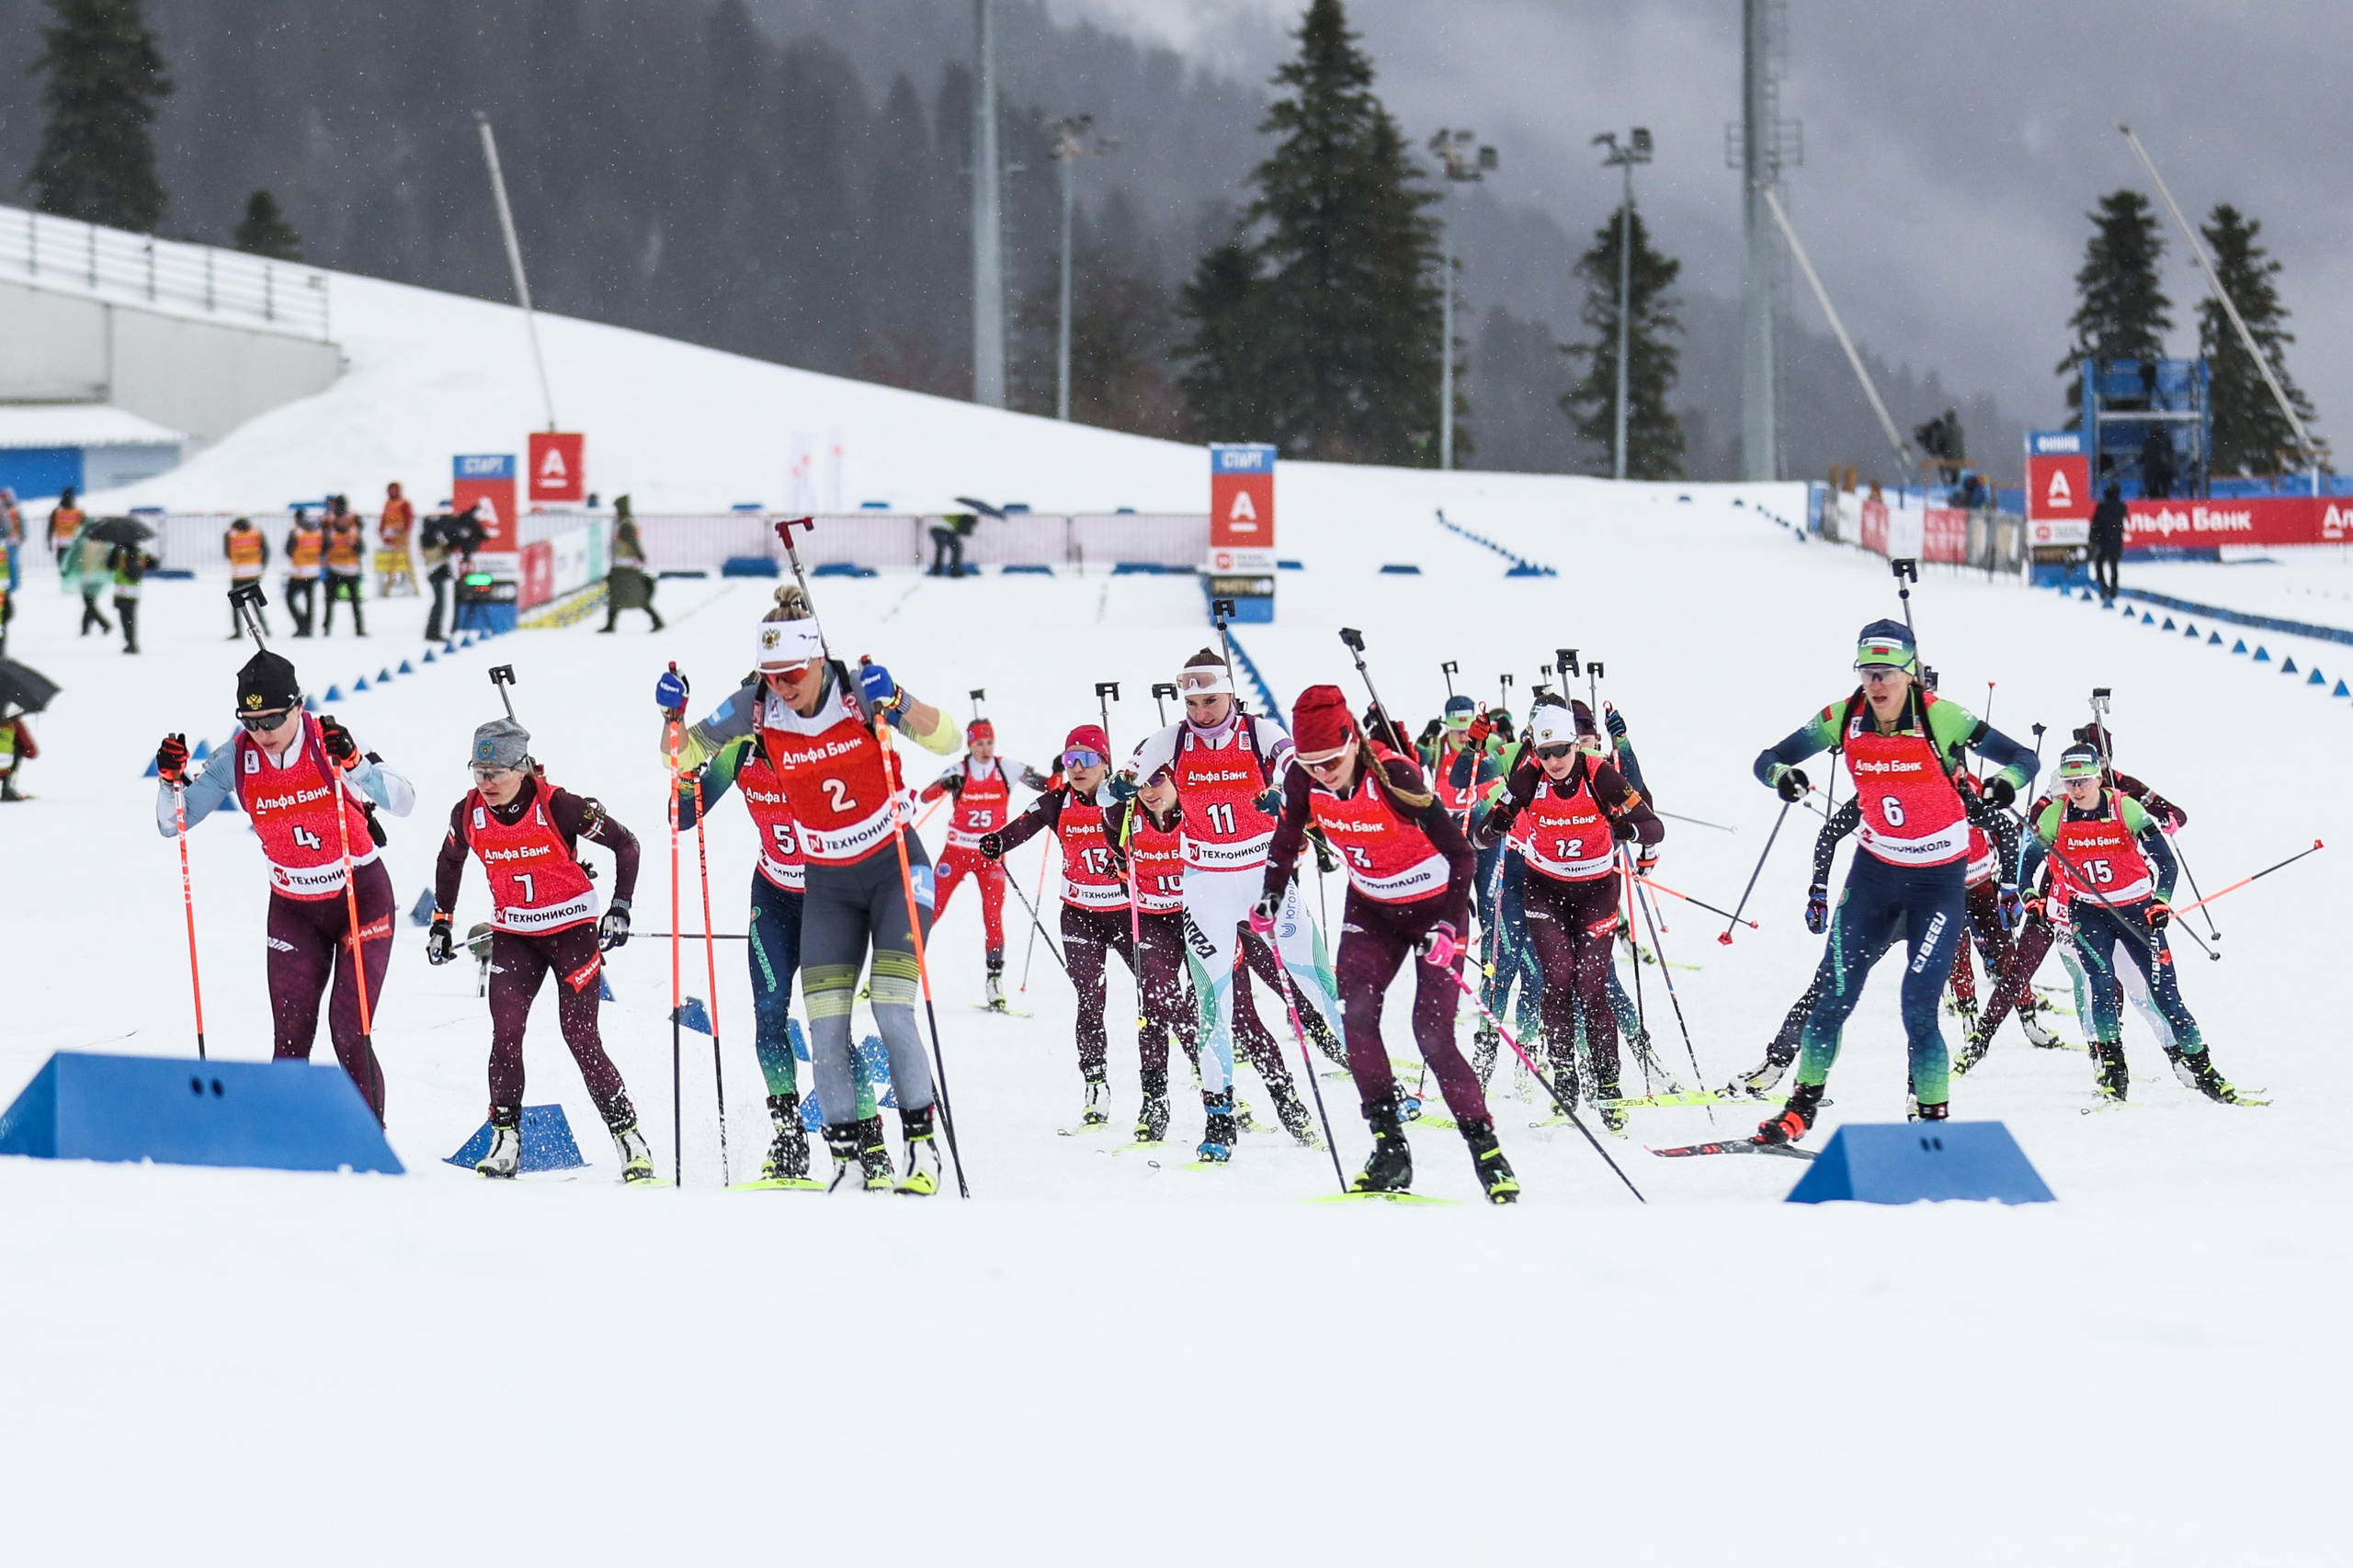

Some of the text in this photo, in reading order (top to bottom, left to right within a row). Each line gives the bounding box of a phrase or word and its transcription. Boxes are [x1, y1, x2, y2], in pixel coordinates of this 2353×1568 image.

[464, 458, 505, 473] СТАРТ
[1222, 451, 1262, 468] СТАРТ
[2123, 507, 2252, 536] льфа Банк
[783, 738, 862, 767] Альфа Банк
[1188, 769, 1247, 782] Альфа Банк
[1855, 758, 1922, 773] Альфа Банк
[256, 785, 331, 811] Альфа Банк
[746, 787, 780, 804] Альфа
[821, 778, 858, 813] 2
[968, 810, 993, 827] 25
[1206, 803, 1236, 835] 11
[1572, 814, 1597, 824] Банк
[1881, 795, 1905, 827] 6
[1066, 824, 1096, 835] Альфа
[1317, 814, 1384, 833] Альфа Банк
[293, 825, 322, 850] 4
[772, 824, 796, 855] 5
[2067, 836, 2120, 847] Альфа Банк
[484, 845, 551, 861] Альфа Банк
[1136, 849, 1169, 861] Альфа
[1346, 846, 1373, 869] 3
[1554, 838, 1584, 858] 12
[1081, 848, 1108, 874] 13
[2082, 859, 2113, 883] 15
[290, 869, 346, 886] ТЕХНОНИ
[513, 873, 535, 903] 7
[1286, 881, 1296, 919] ЮГОРИ
[507, 903, 587, 923] ТЕХНОНИКОЛЬ
